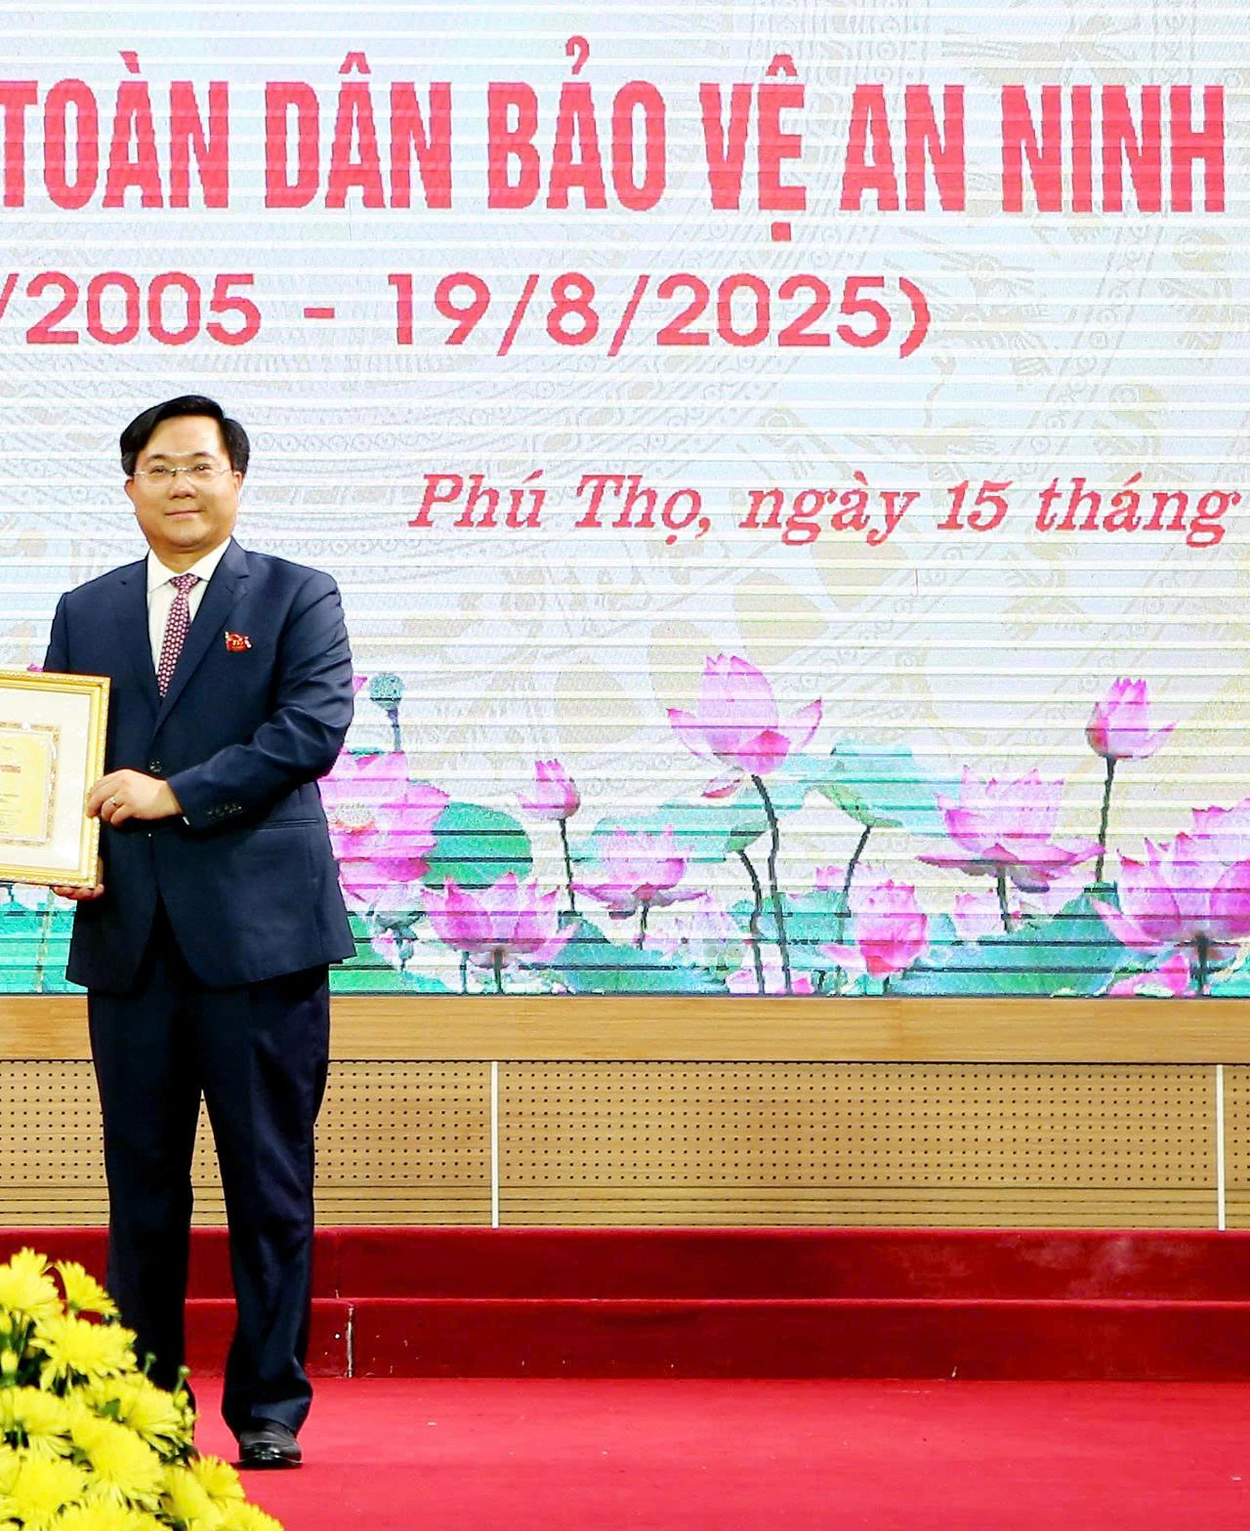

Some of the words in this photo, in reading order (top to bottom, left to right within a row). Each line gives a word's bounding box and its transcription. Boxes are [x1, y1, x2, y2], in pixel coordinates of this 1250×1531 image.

[266, 53, 451, 208] DÂN
[488, 36, 666, 210] BẢO
[700, 54, 806, 241] VỆ
[841, 84, 965, 211] AN
[1002, 85, 1225, 212] NINH
[305, 308, 334, 318] -
[389, 272, 930, 356] 19/8/2025)
[409, 471, 545, 528] Phú
[577, 475, 709, 544] Thọ,
[740, 472, 919, 546] ngày
[938, 480, 1012, 531] 15
[1035, 472, 1241, 547] tháng
